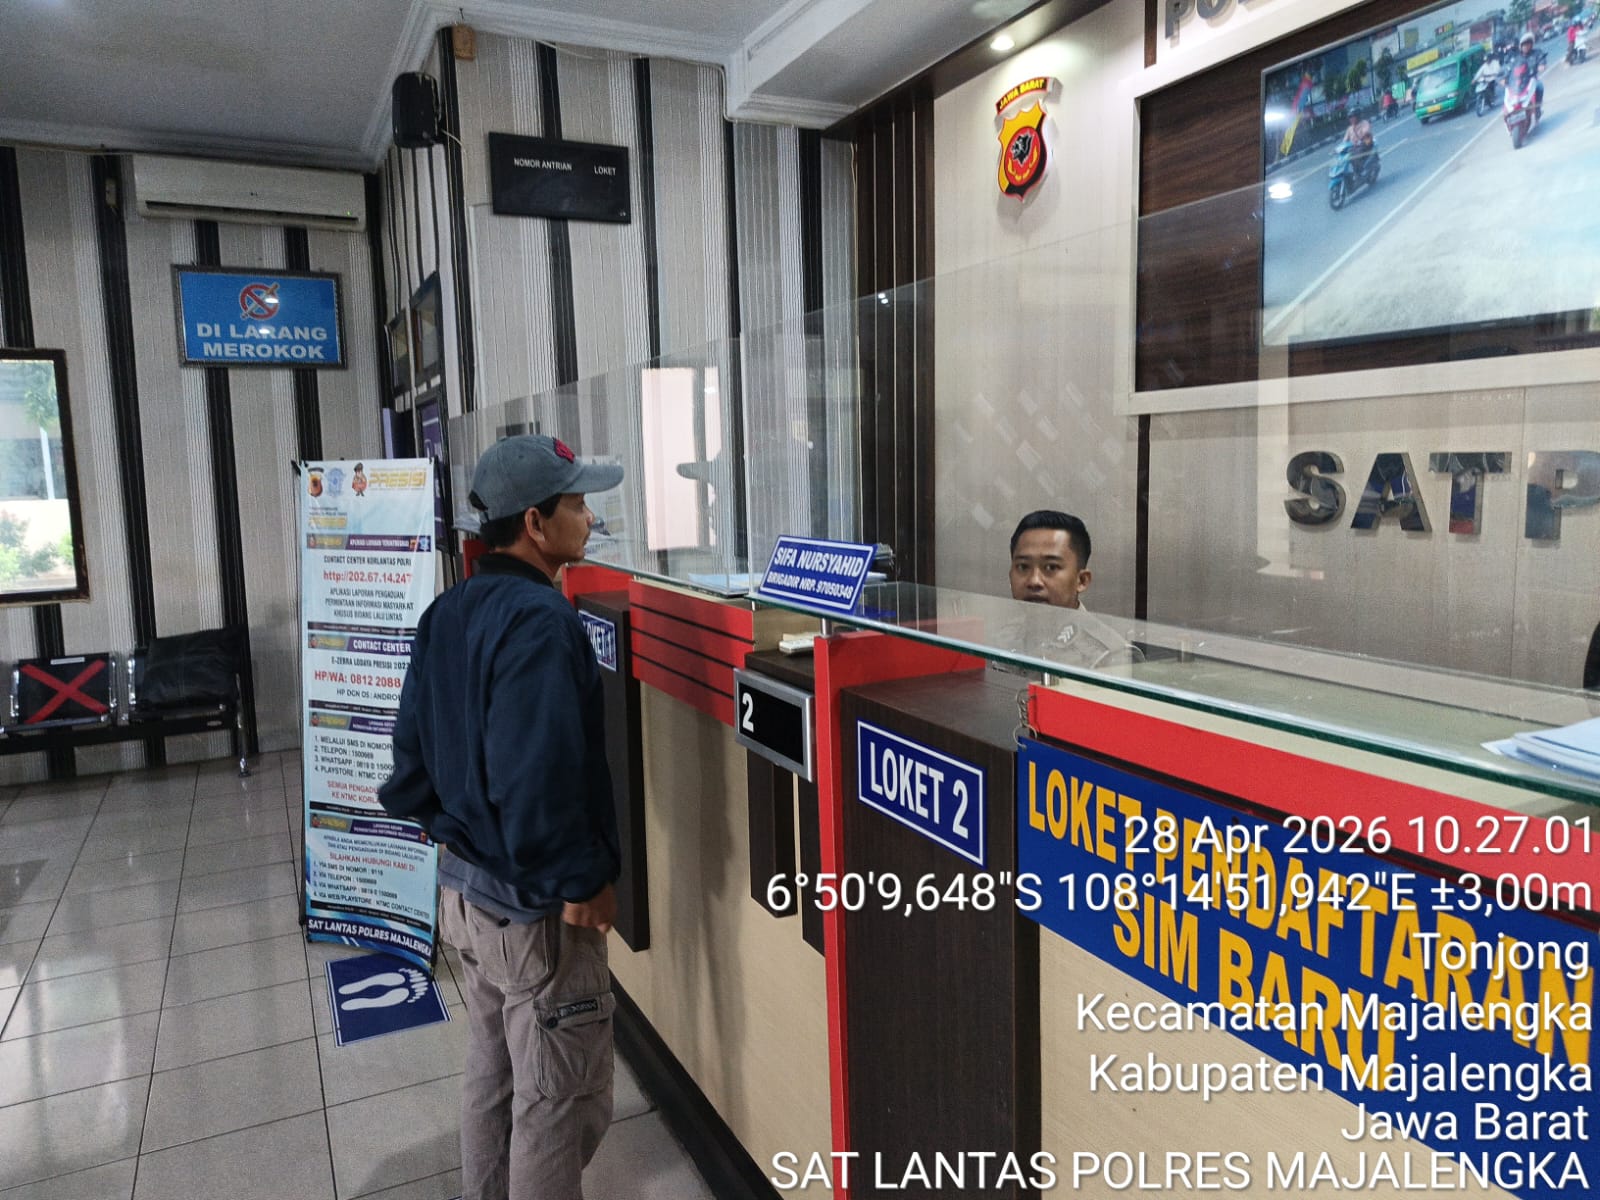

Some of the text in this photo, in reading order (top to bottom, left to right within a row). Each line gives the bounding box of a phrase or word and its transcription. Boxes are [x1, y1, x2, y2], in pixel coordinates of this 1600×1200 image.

[1000, 80, 1044, 109] JAWA BARAT
[514, 157, 616, 176] NOMOR ANTRIAN LOKET
[196, 323, 328, 341] DI LARANG
[203, 342, 325, 360] MEROKOK
[369, 471, 426, 488] PRESISI
[324, 555, 412, 566] CONTACT CENTER KORLANTAS POLRI
[774, 547, 864, 578] SIFA NURSYAHID
[766, 572, 800, 590] BRIGADIR
[799, 577, 816, 593] NRP.
[352, 589, 374, 598] LAPORAN
[356, 599, 382, 608] INFORMASI
[386, 612, 402, 621] LINTAS
[354, 640, 381, 650] CONTACT
[382, 642, 412, 653] CENTER
[315, 670, 348, 684] HP/WA:
[350, 674, 372, 686] 0812
[347, 689, 360, 697] DGN
[742, 692, 754, 732] 2
[320, 736, 345, 745] MELALUI
[347, 738, 358, 747] SMS
[321, 746, 347, 756] TELEPON
[321, 756, 352, 766] WHATSAPP
[321, 766, 353, 777] PLAYSTORE
[358, 771, 376, 780] NTMC
[341, 792, 358, 800] NTMC
[870, 741, 968, 840] LOKET 2
[330, 852, 360, 862] SILAHKAN
[362, 856, 392, 866] HUBUNGI
[393, 861, 408, 870] KAMI
[346, 865, 367, 873] NOMOR
[328, 873, 352, 882] TELEPON
[328, 883, 357, 892] WHATSAPP
[391, 903, 413, 914] CONTACT
[1028, 760, 1594, 1074] LOKET PENDAFTARAN
[308, 919, 324, 929] SAT
[325, 921, 357, 935] LANTAS
[358, 926, 389, 941] POLRES
[1112, 881, 1396, 1091] SIM BARU
